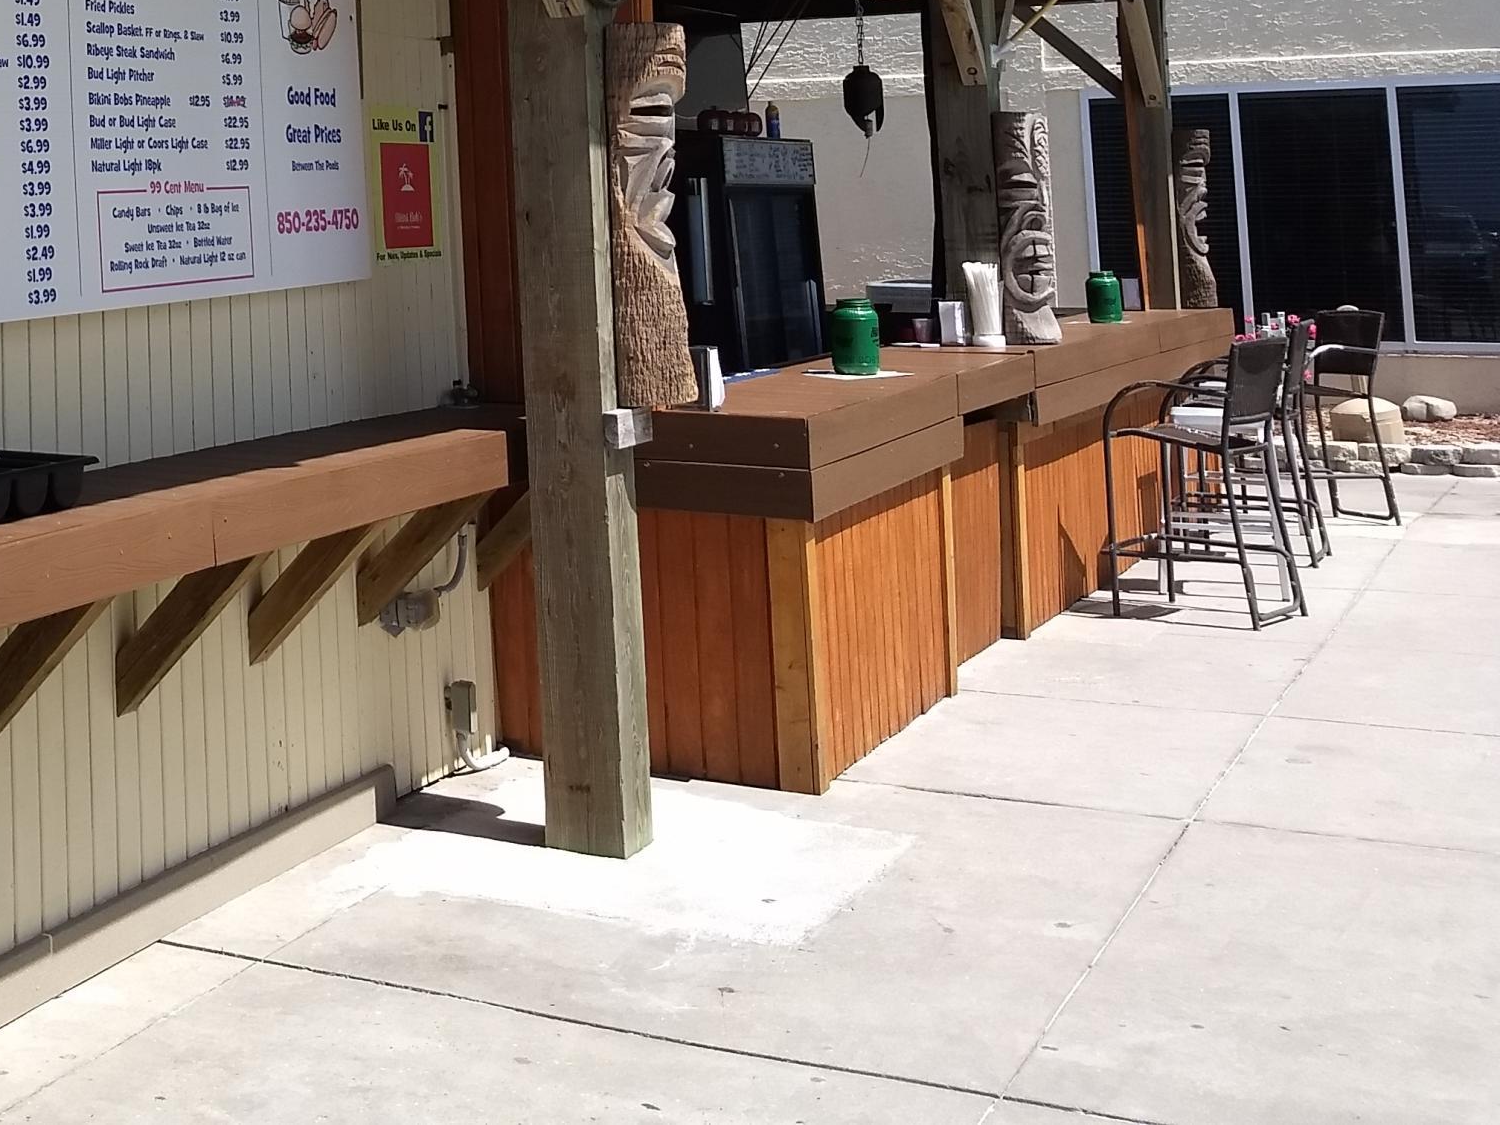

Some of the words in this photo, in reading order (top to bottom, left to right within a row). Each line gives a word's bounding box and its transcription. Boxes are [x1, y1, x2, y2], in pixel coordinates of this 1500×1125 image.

[15, 11, 41, 27] $1.49
[15, 32, 46, 49] $6.99
[16, 53, 50, 70] $10.99
[17, 74, 47, 91] $2.99
[286, 85, 312, 108] Good
[313, 87, 337, 108] Food
[19, 117, 49, 133] $3.99
[372, 118, 389, 130] Like
[392, 119, 403, 131] Us
[405, 120, 416, 131] On
[285, 123, 312, 145] Great
[313, 123, 342, 144] Prices
[20, 138, 50, 154] $6.99
[22, 180, 52, 197] $3.99
[276, 207, 360, 235] 850-235-4750
[25, 244, 55, 262] $2.49
[27, 287, 57, 306] $3.99
